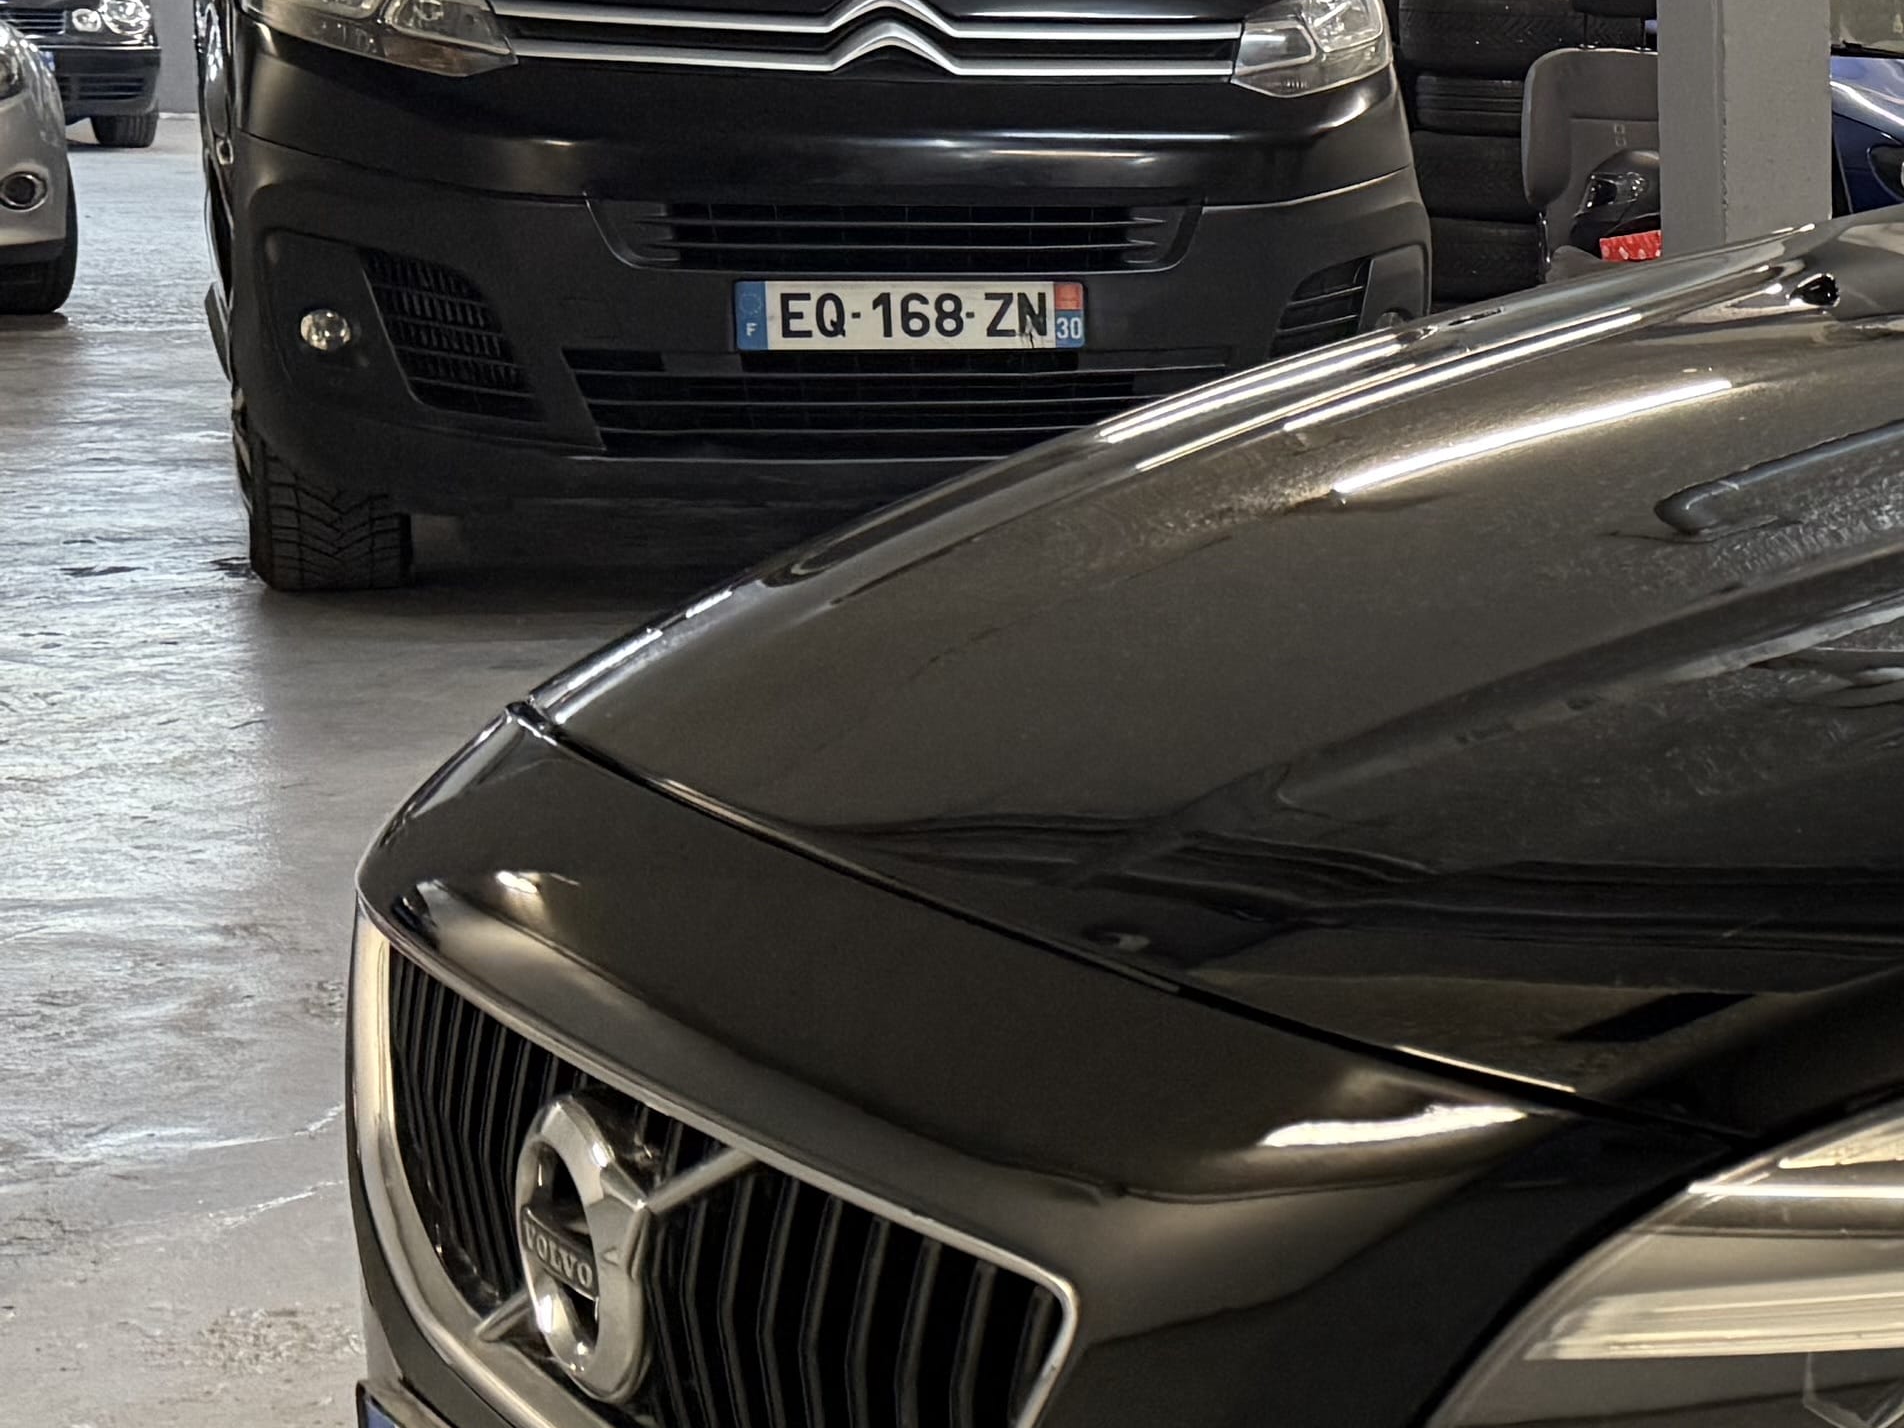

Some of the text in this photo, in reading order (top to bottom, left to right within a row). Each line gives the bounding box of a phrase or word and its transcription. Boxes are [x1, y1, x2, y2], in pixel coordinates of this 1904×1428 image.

[745, 322, 758, 337] F
[780, 291, 1048, 339] EQ-168-ZN
[1056, 317, 1082, 340] 30
[524, 1219, 594, 1288] VOLVO
